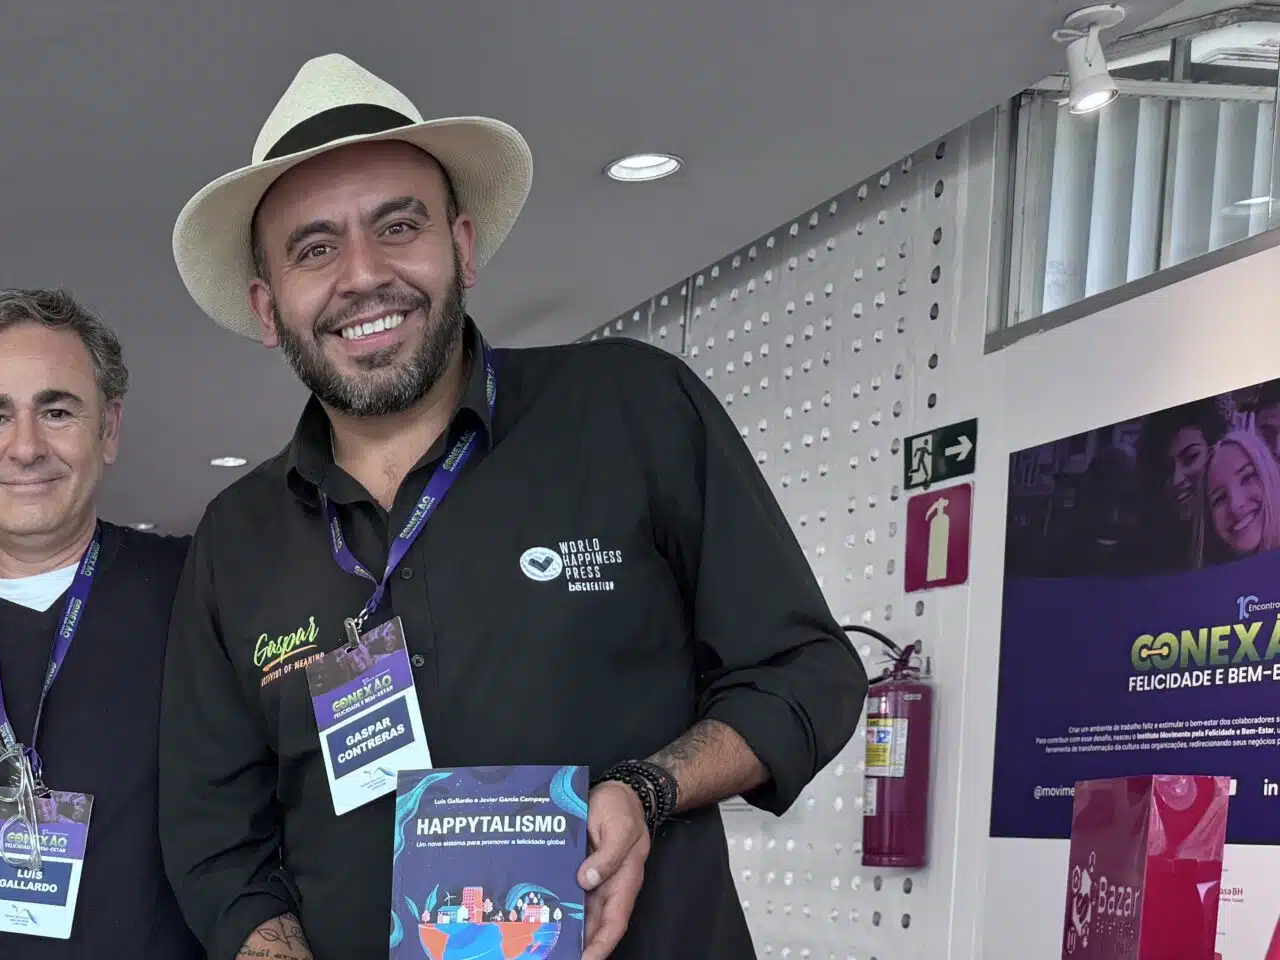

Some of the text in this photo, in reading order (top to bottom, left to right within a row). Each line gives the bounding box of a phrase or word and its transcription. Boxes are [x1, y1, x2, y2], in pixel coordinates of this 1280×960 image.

[559, 538, 600, 554] WORLD
[562, 550, 623, 567] HAPPINESS
[565, 566, 601, 580] PRESS
[254, 616, 319, 667] Gaspar
[1129, 669, 1211, 692] FELICIDADE
[1215, 668, 1225, 685] E
[345, 717, 391, 746] GASPAR
[337, 723, 405, 764] CONTRERAS
[417, 815, 566, 835] HAPPYTALISMO
[17, 869, 43, 880] LUIS
[1097, 875, 1141, 918] Bazar
